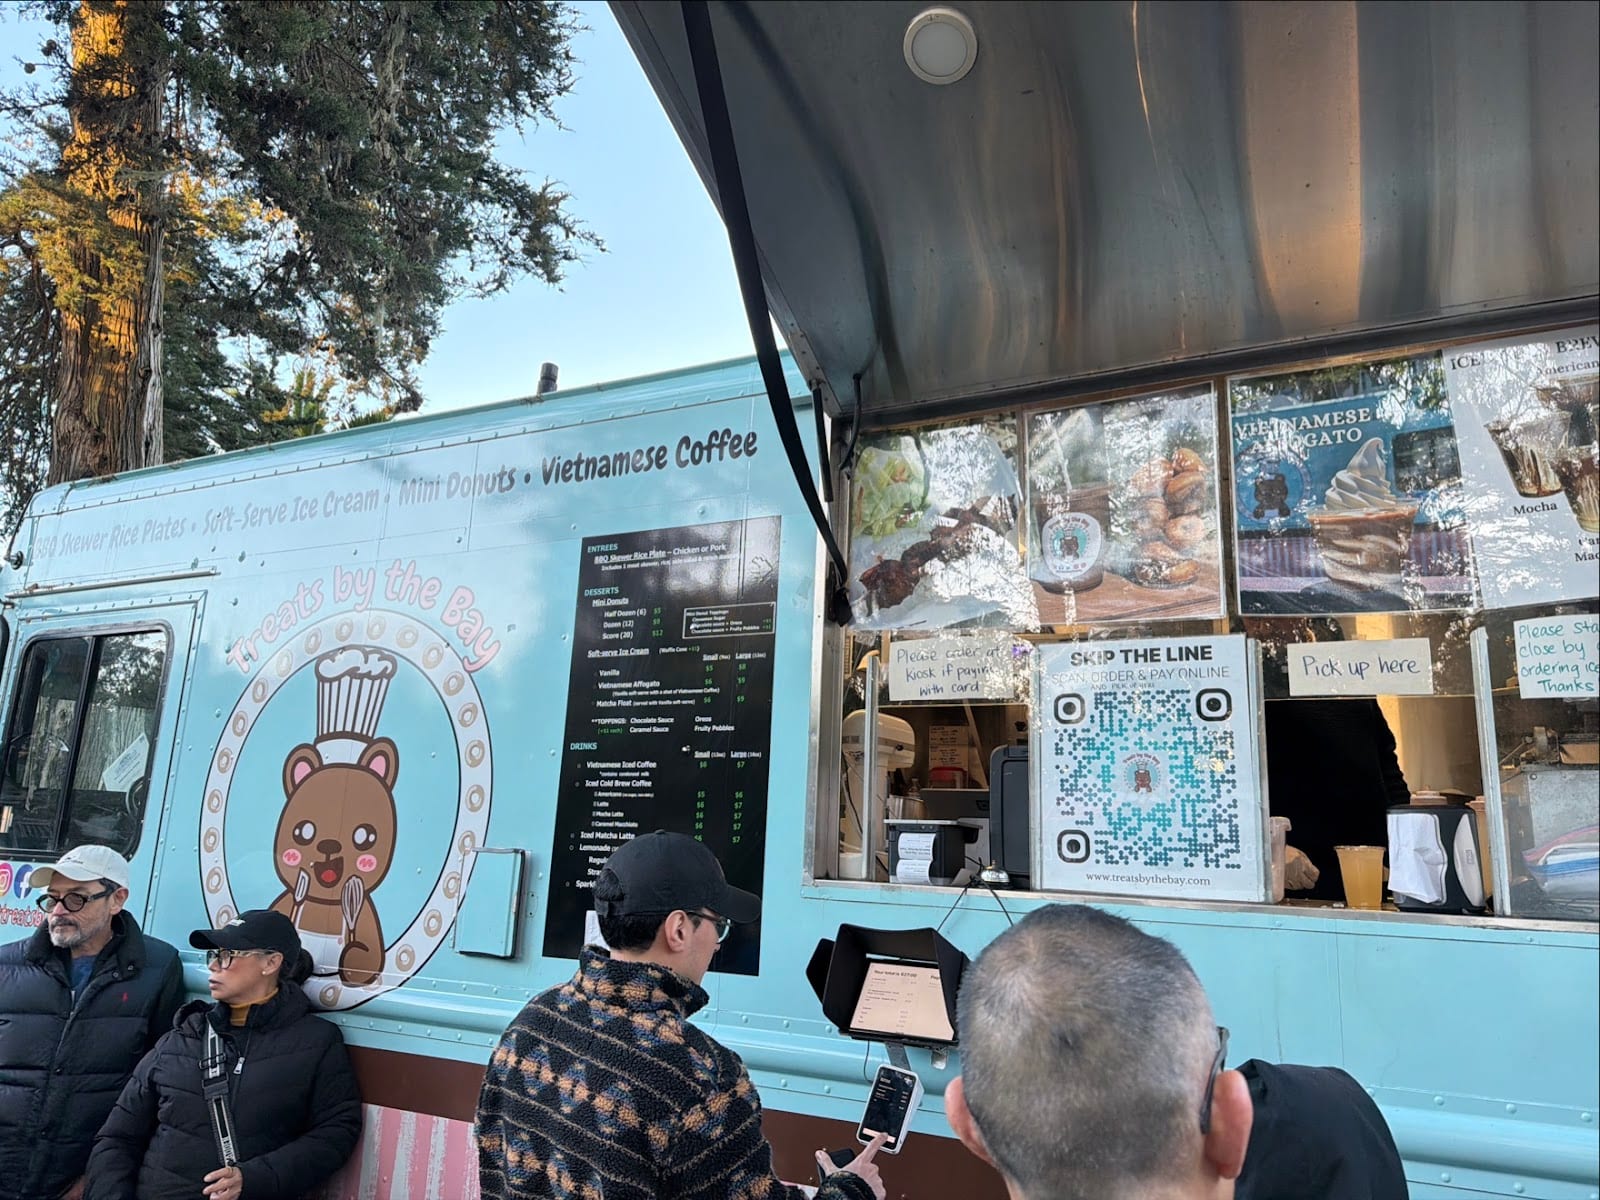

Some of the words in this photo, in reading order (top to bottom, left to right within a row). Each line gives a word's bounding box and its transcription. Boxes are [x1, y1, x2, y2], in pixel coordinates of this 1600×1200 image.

[59, 529, 109, 558] Skewer
[109, 525, 139, 552] Rice
[142, 518, 187, 546] Plates
[202, 503, 288, 536] Soft-Serve
[290, 495, 320, 522] Ice
[323, 487, 380, 518] Cream
[398, 476, 441, 507] Mini
[446, 465, 517, 500] Donuts
[541, 444, 668, 486] Vietnamese
[675, 428, 759, 469] Coffee
[1513, 502, 1558, 515] Mocha
[587, 543, 618, 553] ENTREES
[633, 551, 648, 561] Rice
[673, 546, 700, 555] Chicken
[710, 544, 727, 552] Pork
[584, 586, 619, 597] DESSERTS
[592, 598, 605, 608] Mini
[607, 597, 629, 607] Donuts
[226, 578, 324, 673] Treats
[333, 565, 376, 612] by
[385, 558, 442, 610] the
[441, 585, 501, 673] Bay
[604, 610, 617, 618] Half
[617, 609, 636, 617] Dozen
[637, 607, 647, 616] (6)
[603, 621, 621, 629] Dozen
[602, 632, 620, 640] Score
[620, 631, 633, 640] (20)
[1518, 623, 1564, 639] Please
[1562, 639, 1586, 660] by
[702, 653, 718, 661] Small
[735, 652, 751, 660] Large
[897, 647, 938, 664] Please
[1070, 649, 1116, 667] SKIP
[1120, 646, 1162, 665] THE
[1166, 644, 1213, 662] LINE
[599, 668, 620, 677] Vanilla
[942, 662, 954, 677] if
[1091, 669, 1135, 682] ORDER
[1137, 669, 1148, 680] &
[1150, 667, 1174, 680] PAY
[1177, 665, 1231, 679] ONLINE
[1302, 655, 1343, 677] Pick
[1348, 660, 1370, 681] up
[1378, 655, 1421, 675] here
[1520, 660, 1580, 680] ordering
[598, 682, 633, 690] Vietnamese
[633, 680, 660, 689] Affogato
[919, 683, 944, 697] with
[951, 680, 980, 693] card
[1537, 679, 1595, 693] Thanks
[694, 725, 711, 733] Fruity
[570, 742, 598, 750] DRINKS
[694, 750, 711, 758] Small
[730, 750, 747, 758] Large
[586, 761, 621, 769] Vietnamese
[621, 761, 636, 769] Iced
[636, 760, 657, 769] Coffee
[737, 761, 745, 769] $7
[585, 780, 599, 788] Iced
[599, 779, 614, 787] Cold
[614, 779, 631, 787] Brew
[631, 779, 652, 787] Coffee
[734, 801, 743, 809] $7
[580, 831, 595, 839] Iced
[595, 831, 618, 839] Matcha
[618, 832, 635, 840] Latte
[732, 835, 741, 843] $7
[579, 843, 611, 852] Lemonade
[588, 856, 608, 865] Regul
[587, 868, 601, 876] Stra
[576, 880, 596, 888] Spark
[1086, 872, 1211, 888] www.treatsbythebay.com
